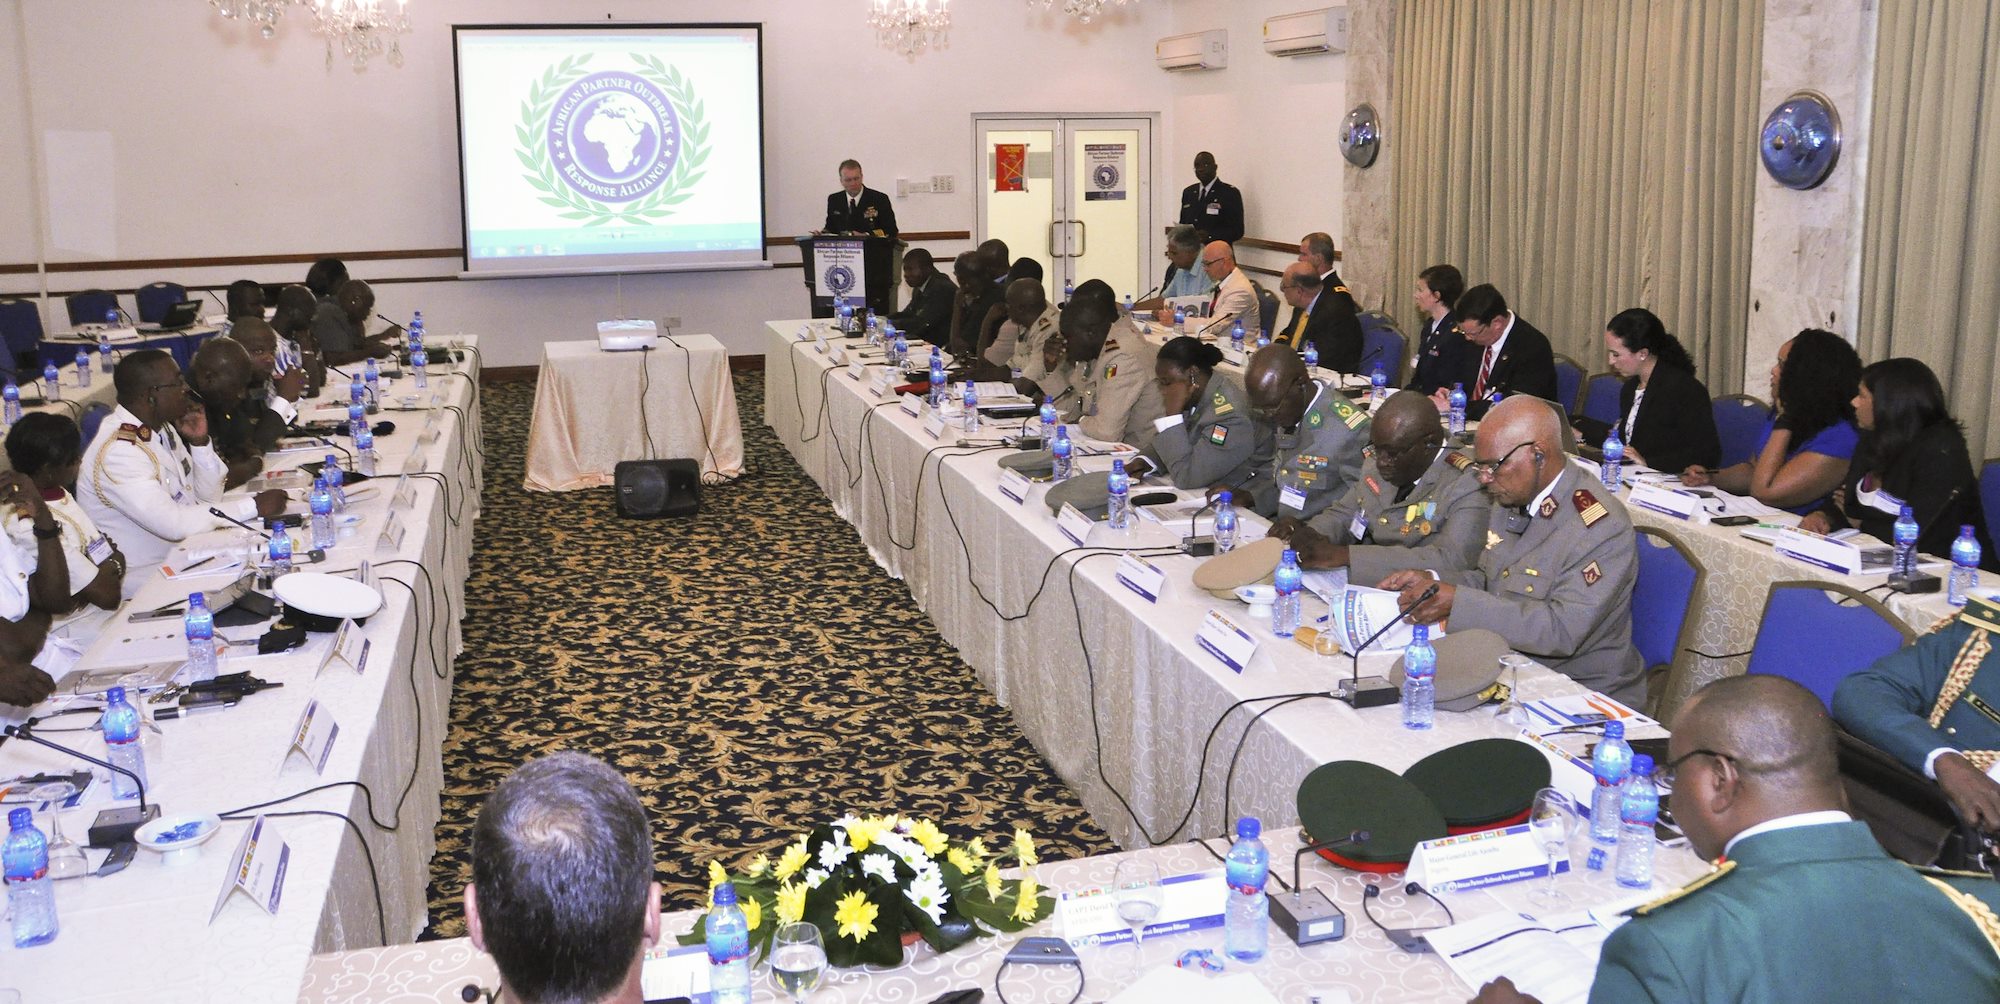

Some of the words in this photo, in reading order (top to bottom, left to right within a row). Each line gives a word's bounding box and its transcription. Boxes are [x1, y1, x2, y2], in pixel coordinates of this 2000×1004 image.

[552, 90, 583, 136] AFRICAN
[580, 77, 632, 95] PARTNER
[634, 82, 673, 134] OUTBREAK
[564, 163, 616, 197] RESPONSE
[620, 161, 667, 197] ALLIANCE
